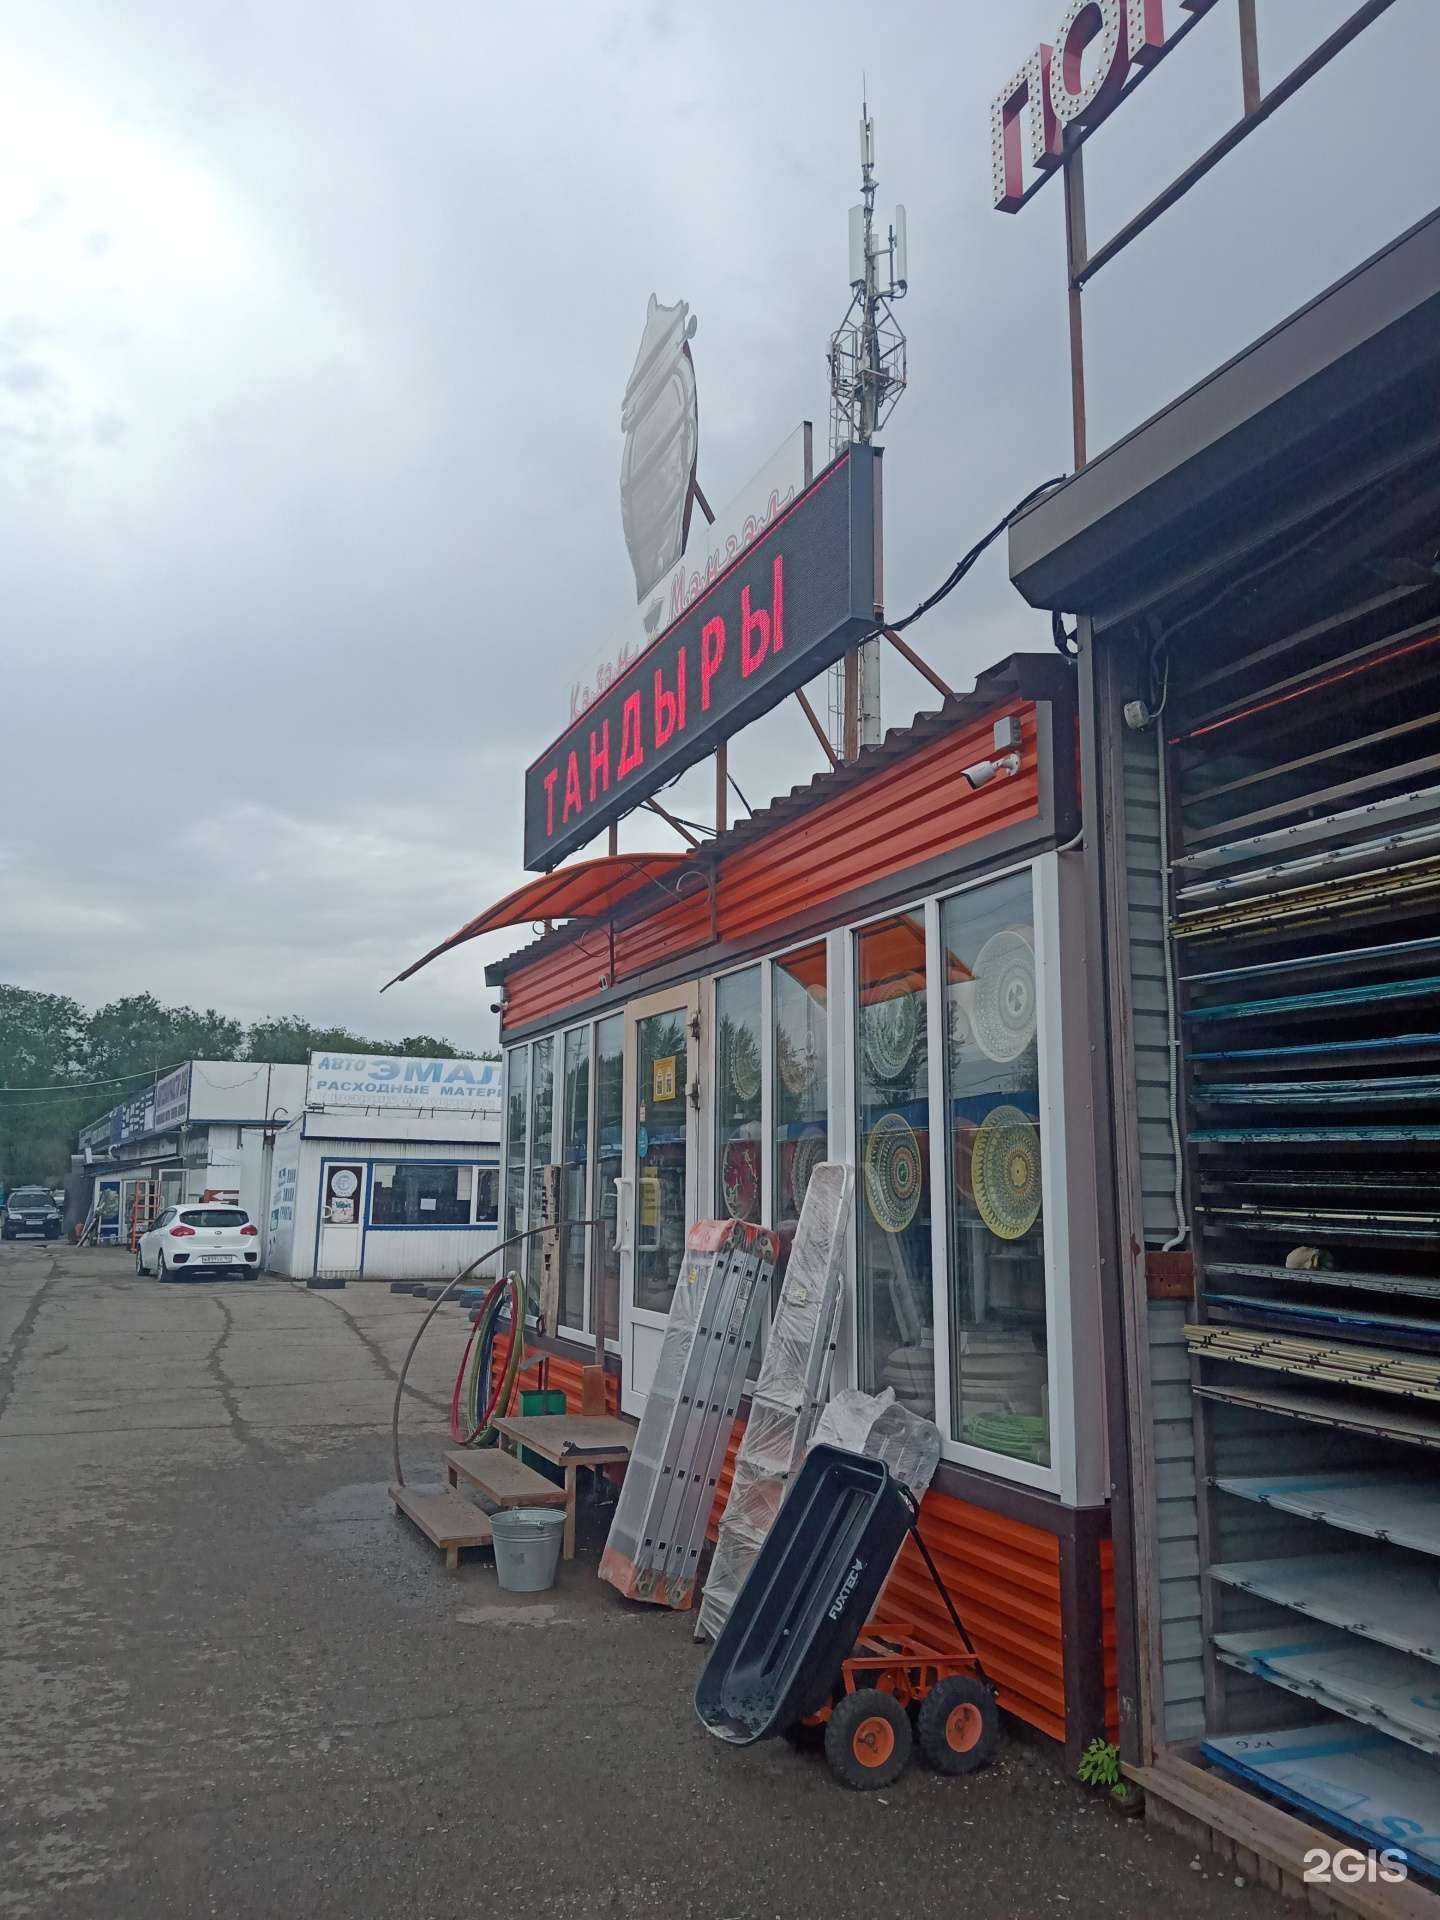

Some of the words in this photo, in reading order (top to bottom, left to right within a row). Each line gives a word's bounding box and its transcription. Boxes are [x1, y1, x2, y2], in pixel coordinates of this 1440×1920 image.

[990, 0, 1210, 215] ПО
[543, 554, 784, 838] ТАНДЫРЫ
[317, 1081, 429, 1096] РАСХОДНЫЕ
[318, 1057, 366, 1072] АВТО
[829, 1569, 858, 1619] FUXTEC
